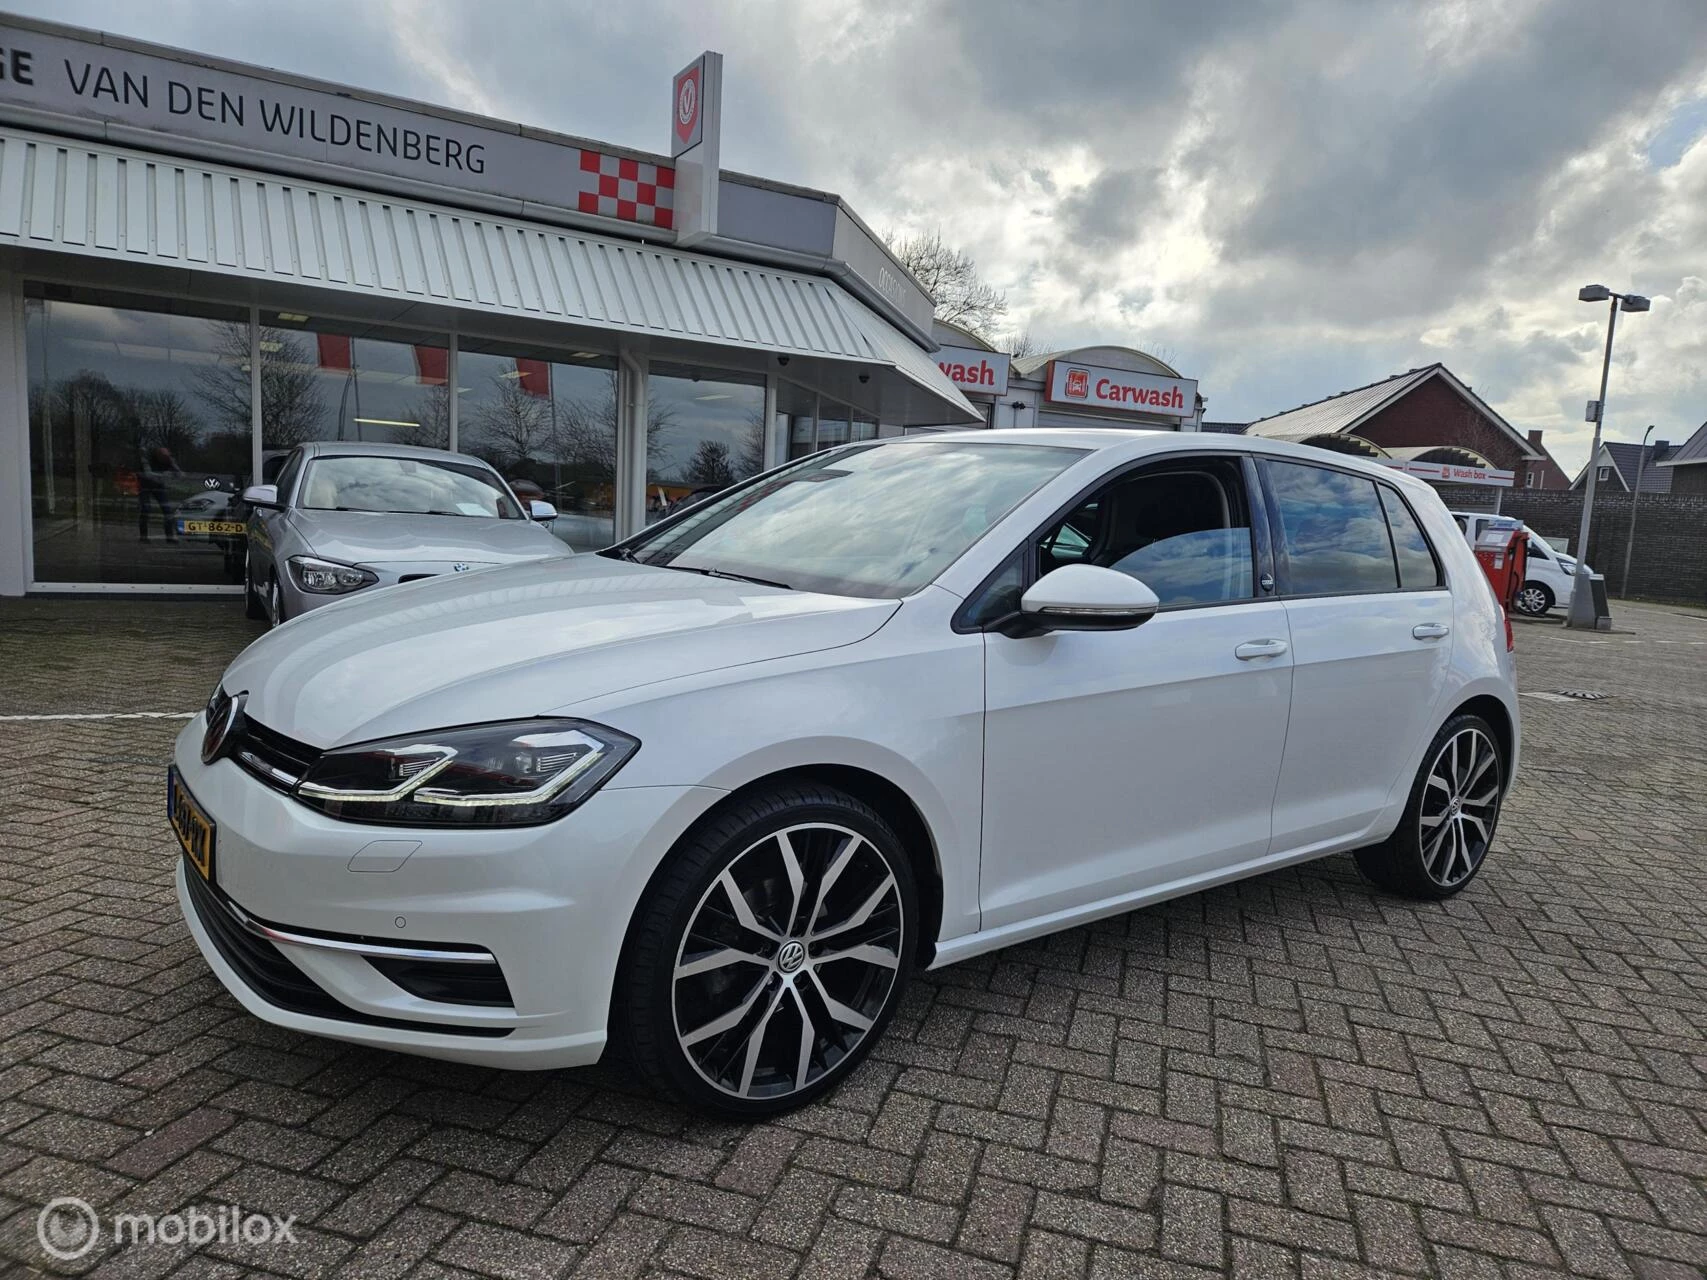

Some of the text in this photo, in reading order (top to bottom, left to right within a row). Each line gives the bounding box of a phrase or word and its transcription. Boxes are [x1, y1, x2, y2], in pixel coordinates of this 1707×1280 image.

[0, 48, 485, 174] E VAN DEN WILDENBERG
[1095, 378, 1184, 409] Carwash
[1453, 467, 1486, 480] Wash box
